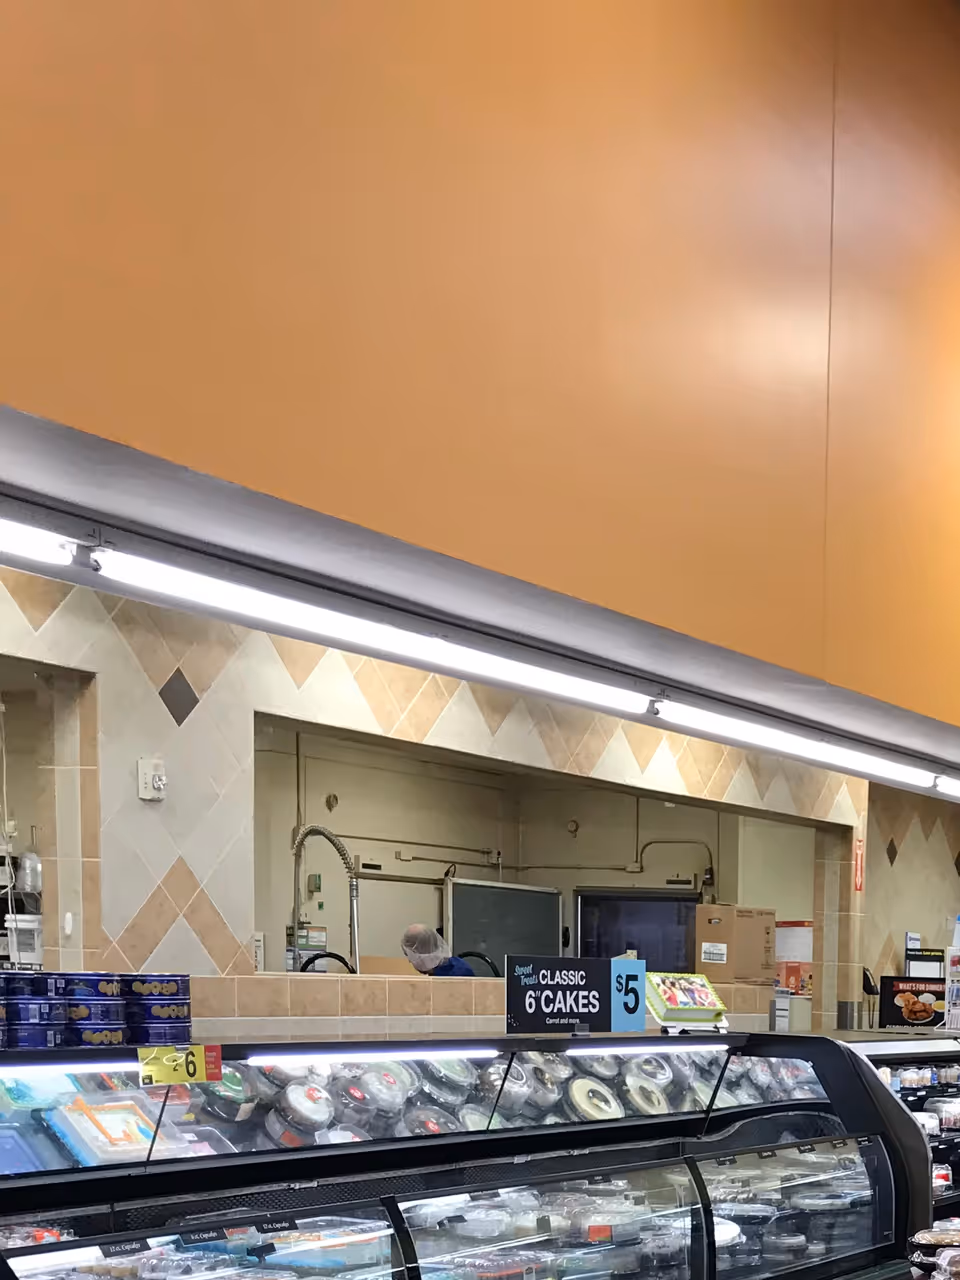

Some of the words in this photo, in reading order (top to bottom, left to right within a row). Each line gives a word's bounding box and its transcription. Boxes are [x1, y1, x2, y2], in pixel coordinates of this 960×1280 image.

[514, 964, 533, 976] Sweet
[539, 969, 586, 985] CLASSIC
[520, 975, 538, 986] Treats
[541, 989, 600, 1013] CAKES
[616, 974, 640, 1014] $5
[185, 1051, 197, 1078] 6
